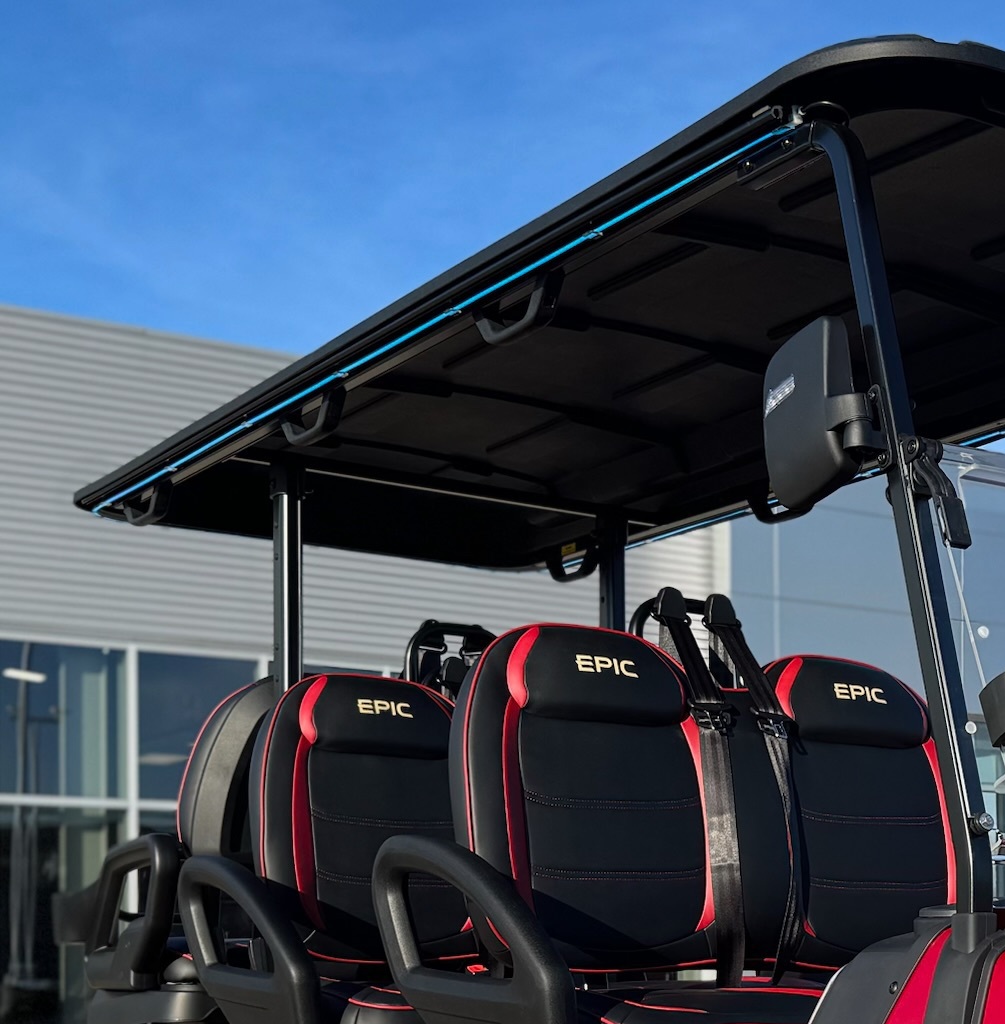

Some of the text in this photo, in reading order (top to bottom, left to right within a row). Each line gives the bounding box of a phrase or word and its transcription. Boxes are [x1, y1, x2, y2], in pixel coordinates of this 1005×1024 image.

[575, 653, 639, 678] EPIC
[833, 682, 887, 704] EPIC
[357, 699, 413, 718] EPIC
